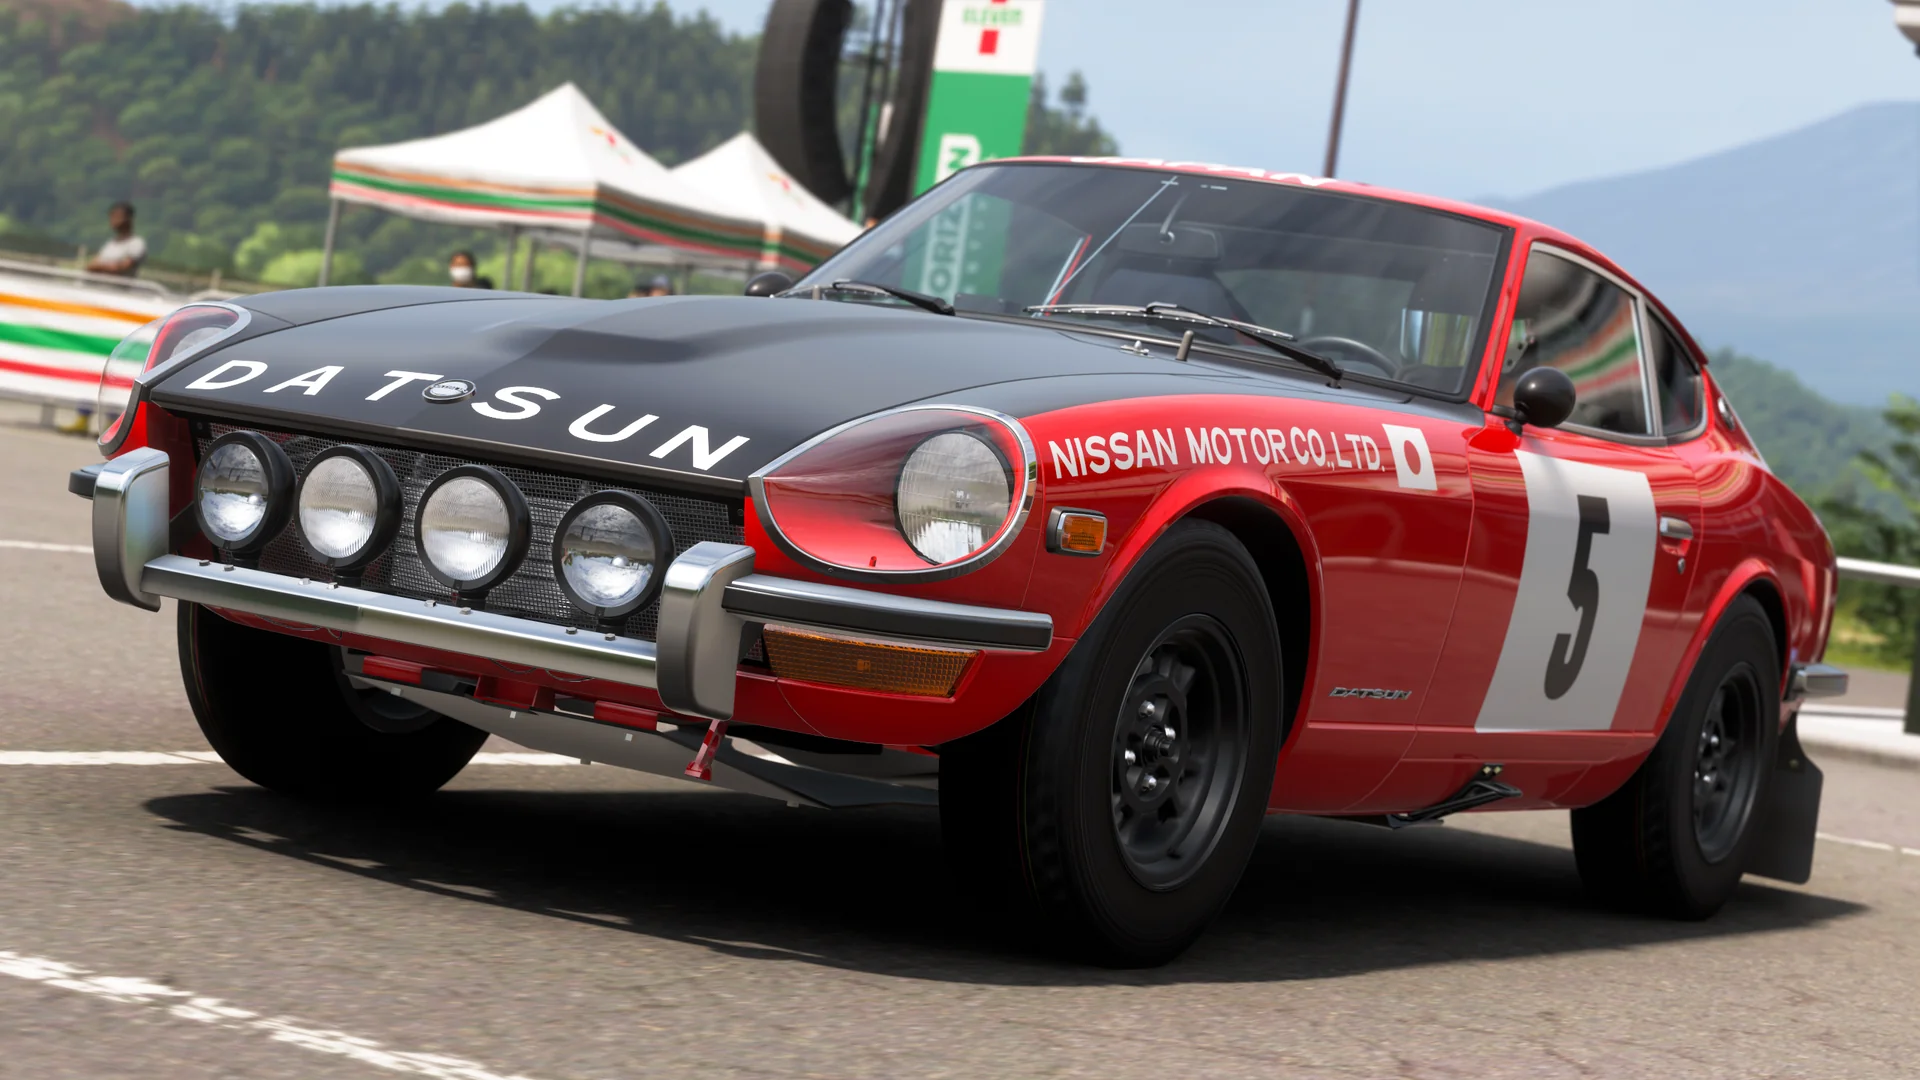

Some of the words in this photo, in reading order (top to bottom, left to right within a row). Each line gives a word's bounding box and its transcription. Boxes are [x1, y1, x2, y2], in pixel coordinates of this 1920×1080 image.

[185, 359, 750, 471] DATSUN
[1048, 427, 1178, 479] NISSAN
[1185, 426, 1290, 465] MOTOR
[1544, 494, 1610, 700] 5
[1328, 687, 1413, 700] DATSUN
